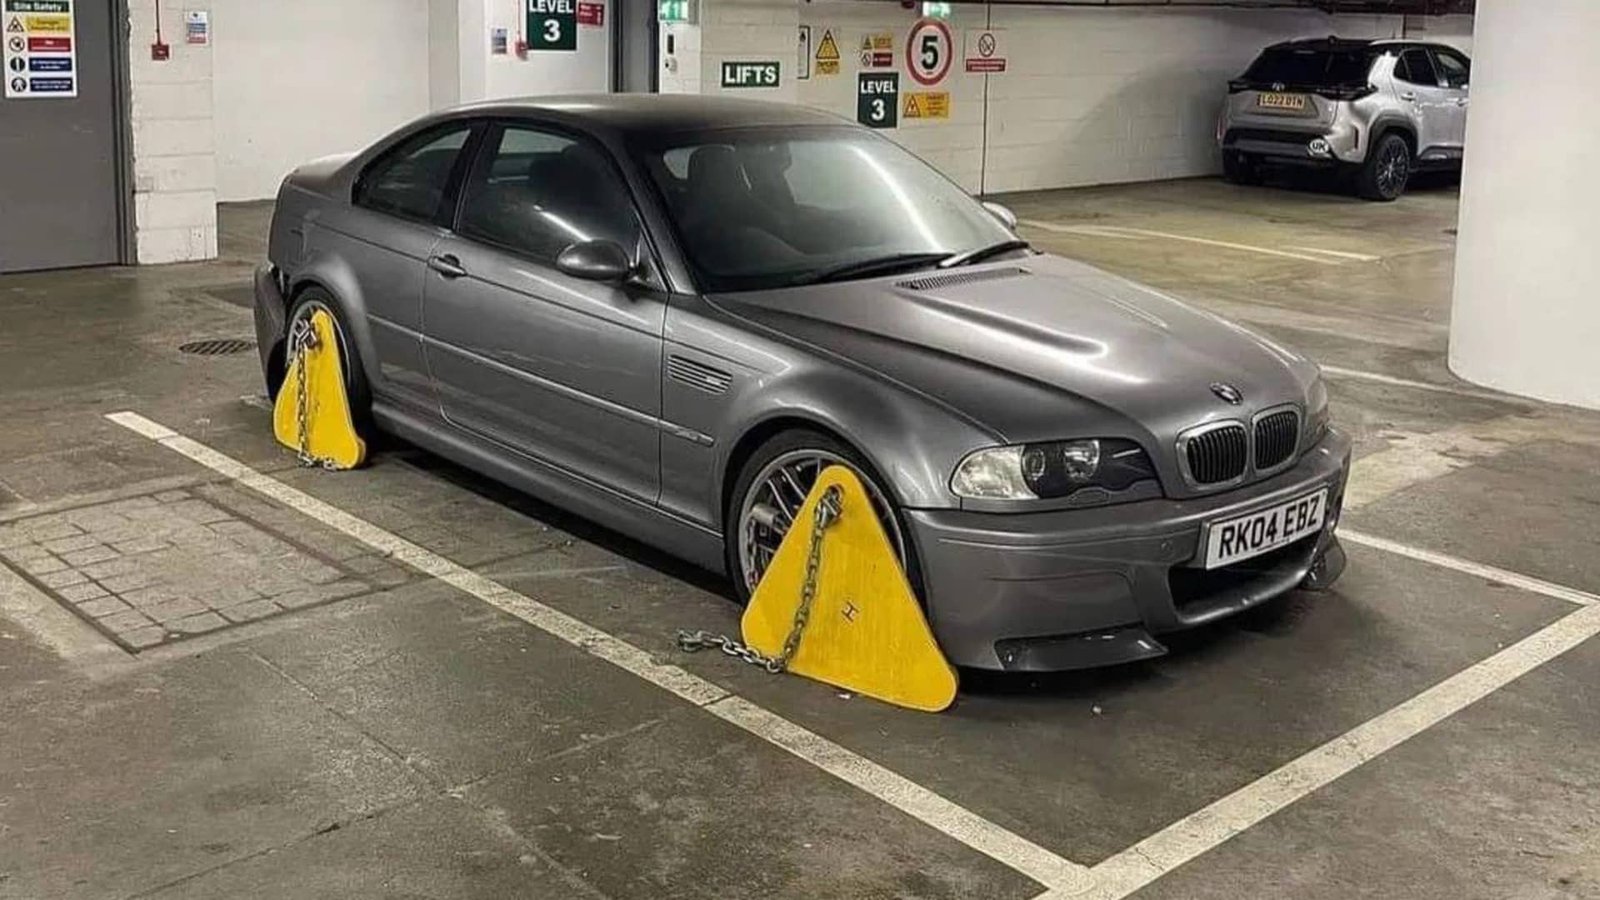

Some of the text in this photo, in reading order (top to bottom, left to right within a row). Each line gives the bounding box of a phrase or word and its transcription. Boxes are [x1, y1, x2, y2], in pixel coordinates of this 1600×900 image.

[529, 0, 574, 13] LEVEL
[543, 19, 561, 42] 3
[921, 35, 939, 70] 5
[724, 65, 776, 84] LIFTS
[860, 80, 896, 94] LEVEL
[871, 98, 886, 121] 3
[1311, 141, 1326, 151] UK
[1218, 494, 1320, 559] RK04 EBZ
